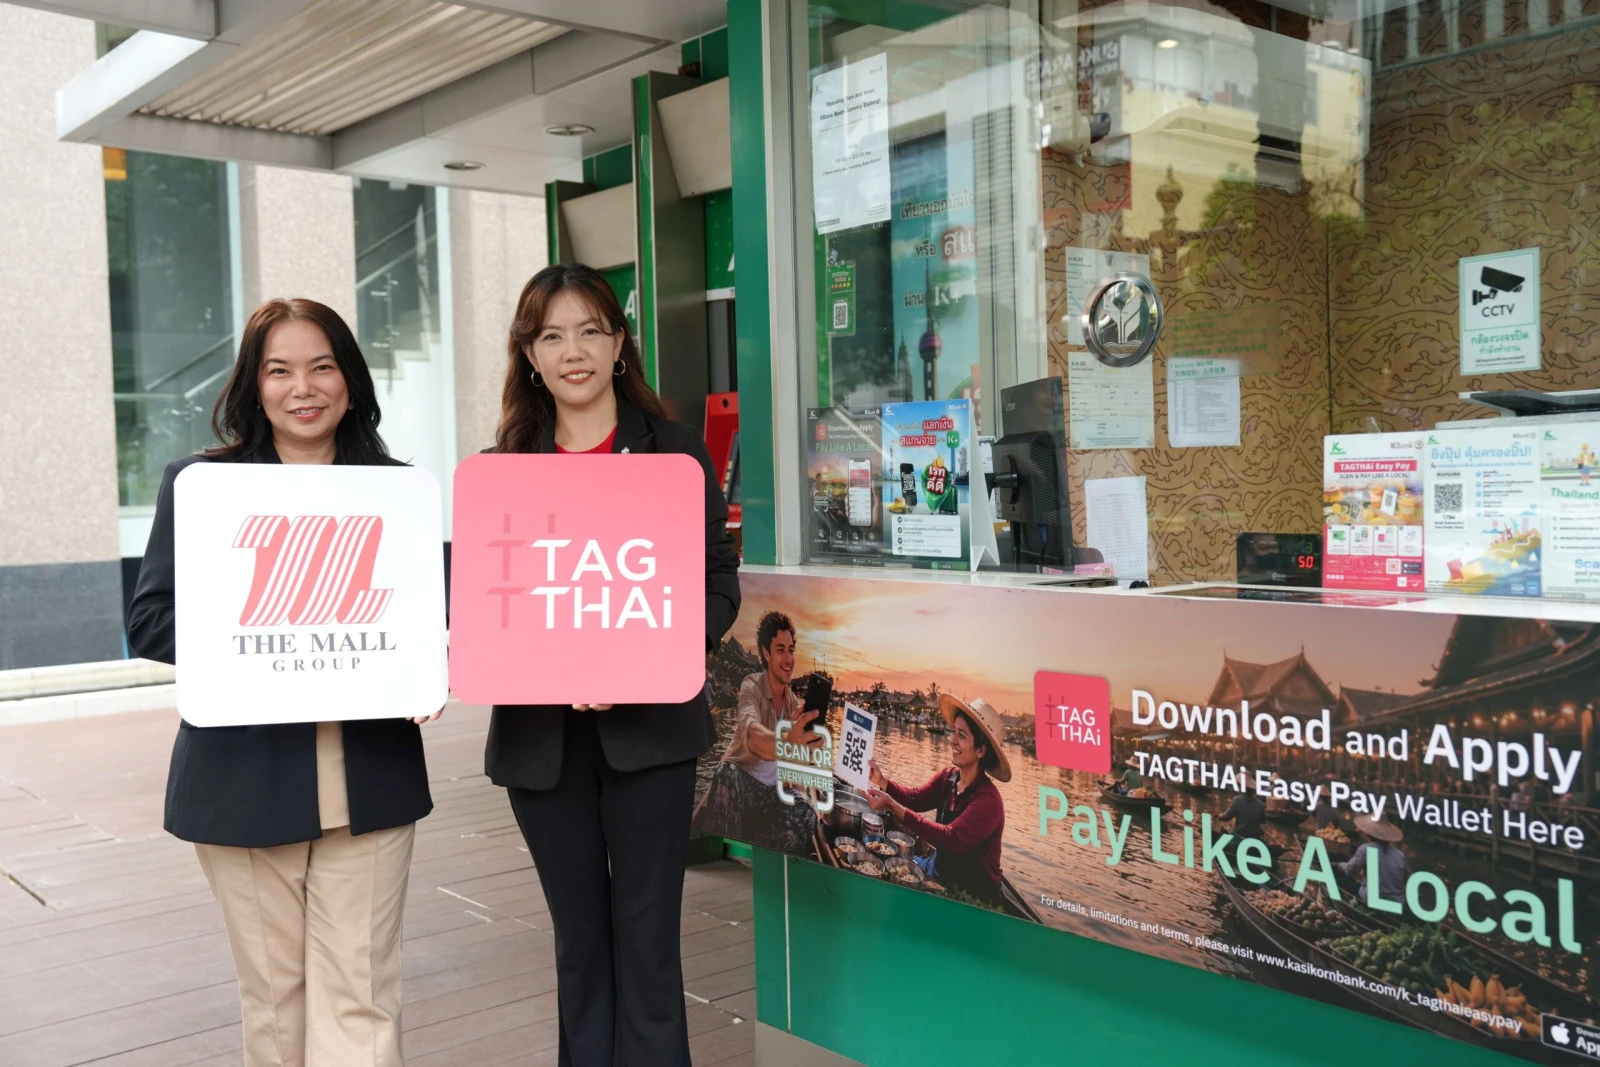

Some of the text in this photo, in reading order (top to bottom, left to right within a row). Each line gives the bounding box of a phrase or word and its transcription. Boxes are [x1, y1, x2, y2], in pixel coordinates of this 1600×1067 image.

[1481, 303, 1515, 318] CCTV
[859, 424, 873, 432] Apply
[815, 443, 828, 453] Pay
[829, 442, 845, 451] Like
[853, 441, 873, 452] Local
[1339, 460, 1411, 472] TAGTHAi Easy Pay
[1550, 487, 1599, 501] Thailand
[530, 538, 657, 582] TAG
[1298, 555, 1314, 569] 50
[530, 585, 673, 630] THAi
[232, 631, 397, 656] THE MALL
[271, 656, 362, 673] GROUP
[1056, 704, 1097, 727] TAG
[1056, 722, 1101, 747] THAi
[1131, 689, 1583, 796] Download and Apply
[776, 741, 832, 767] SCAN QR
[777, 769, 833, 792] EVERYWHERE
[1133, 750, 1586, 851] TAGTHAi Easy Pay Wallet Here
[1037, 785, 1583, 956] Pay Like A Local
[1040, 894, 1523, 1034] For details, limitations and terms, please visit www.kasikornbank.com/k_tagthaieasypay
